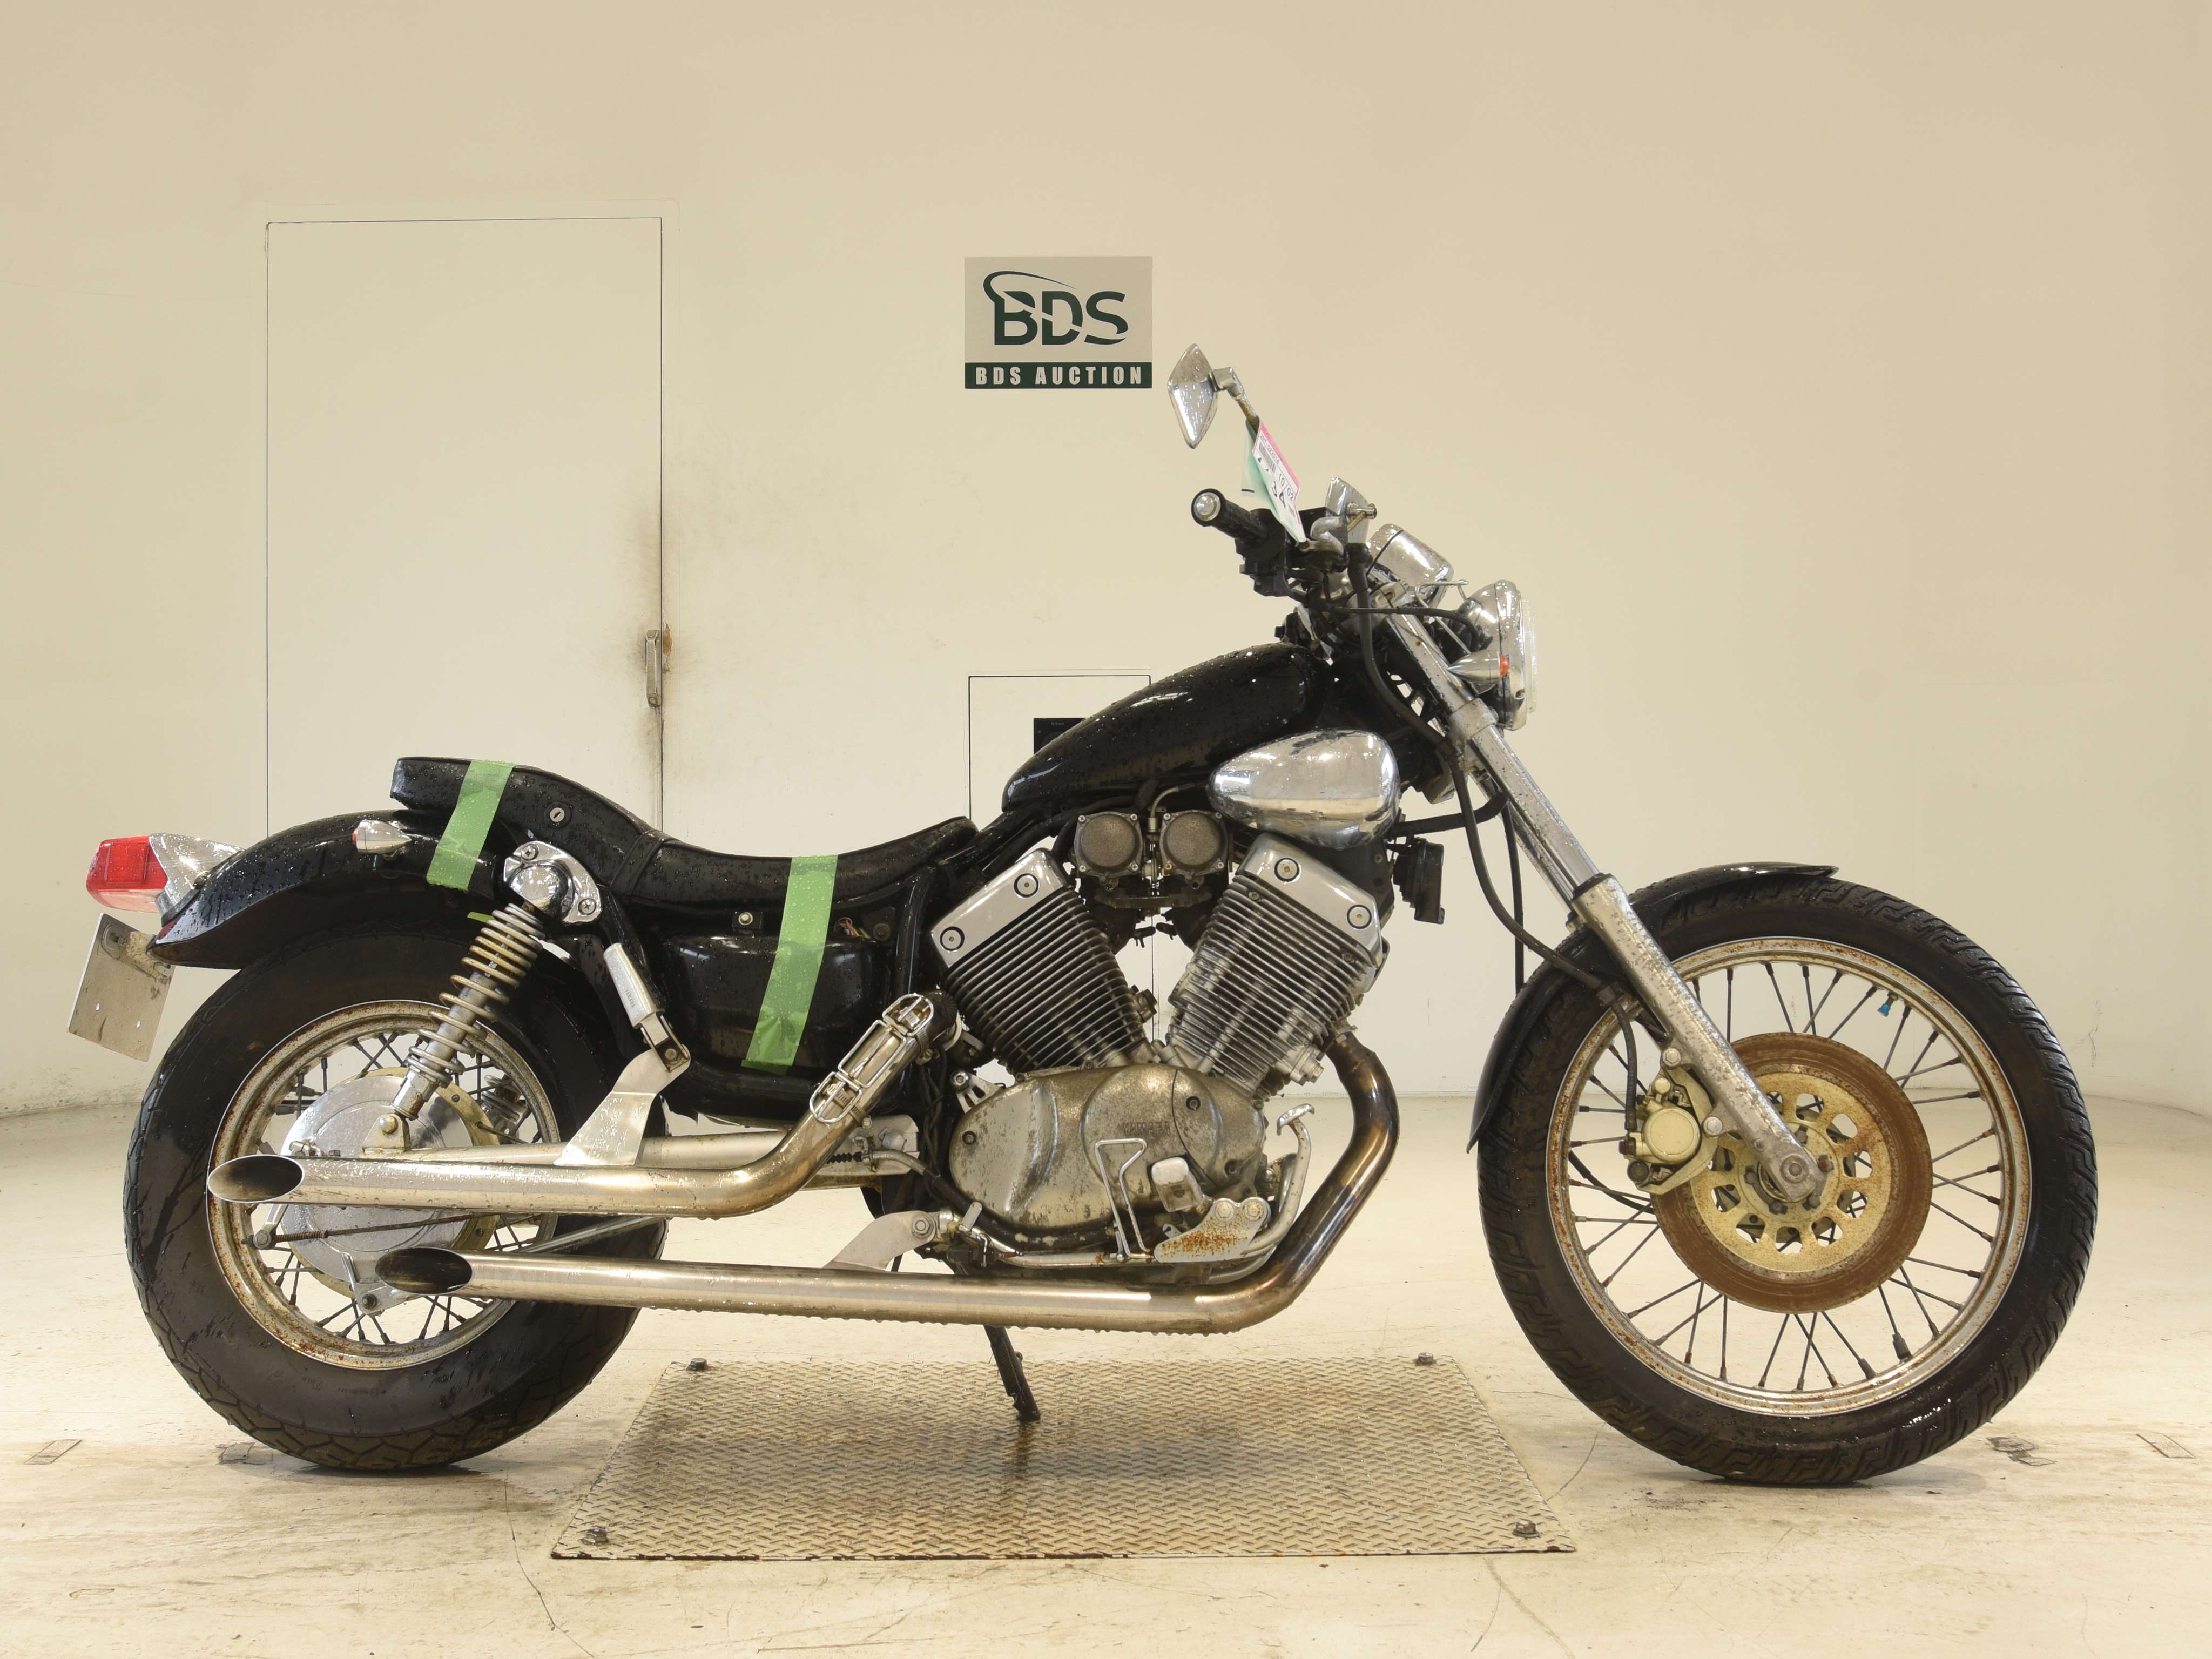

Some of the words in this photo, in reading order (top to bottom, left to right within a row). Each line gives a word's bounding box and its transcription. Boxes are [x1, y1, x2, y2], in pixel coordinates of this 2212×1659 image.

[983, 271, 1129, 346] BDS
[975, 367, 1021, 385] BDS
[1035, 366, 1141, 385] AUCTION
[1123, 1121, 1171, 1136] YAMAHA
